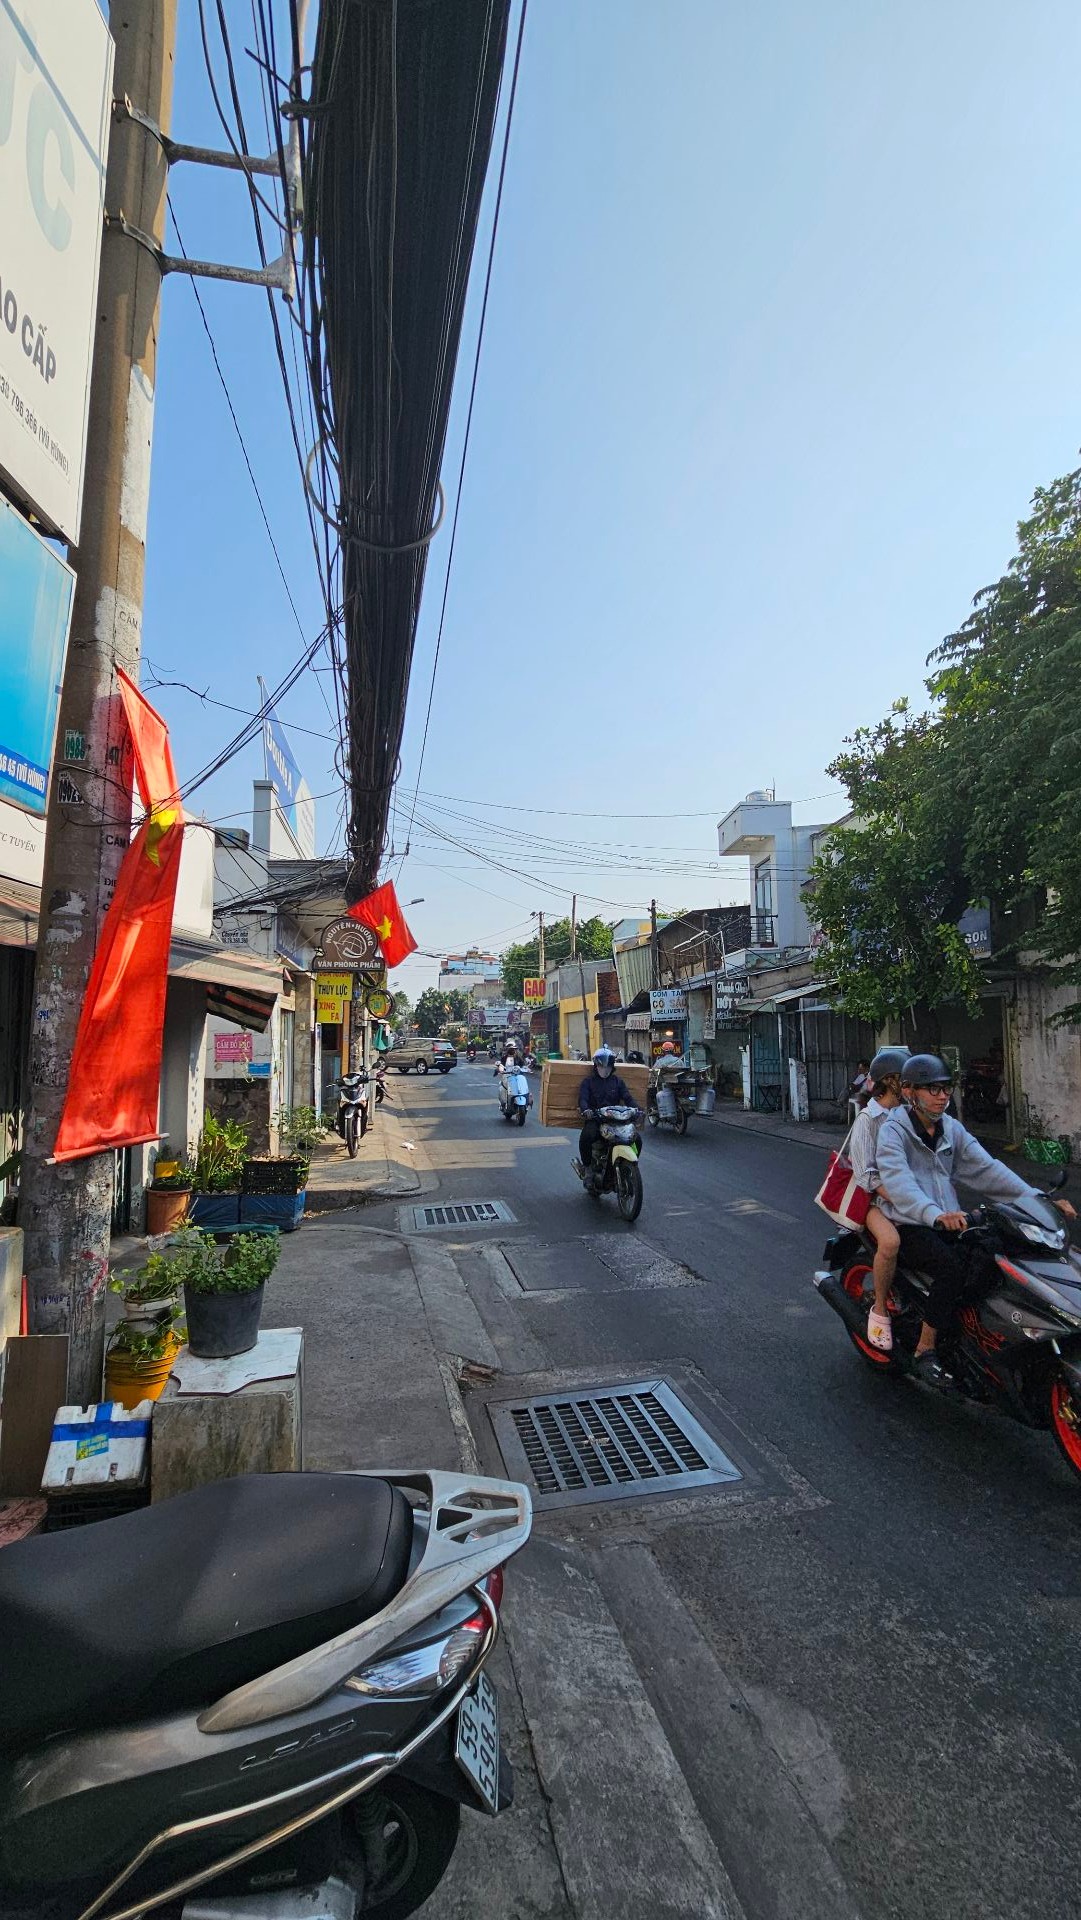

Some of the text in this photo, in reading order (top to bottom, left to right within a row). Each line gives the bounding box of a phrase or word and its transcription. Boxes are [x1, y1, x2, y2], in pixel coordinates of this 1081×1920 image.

[0, 276, 18, 334] O
[0, 374, 10, 400] 30
[11, 388, 24, 418] 796
[319, 1001, 336, 1011] XING
[330, 1012, 340, 1021] FA
